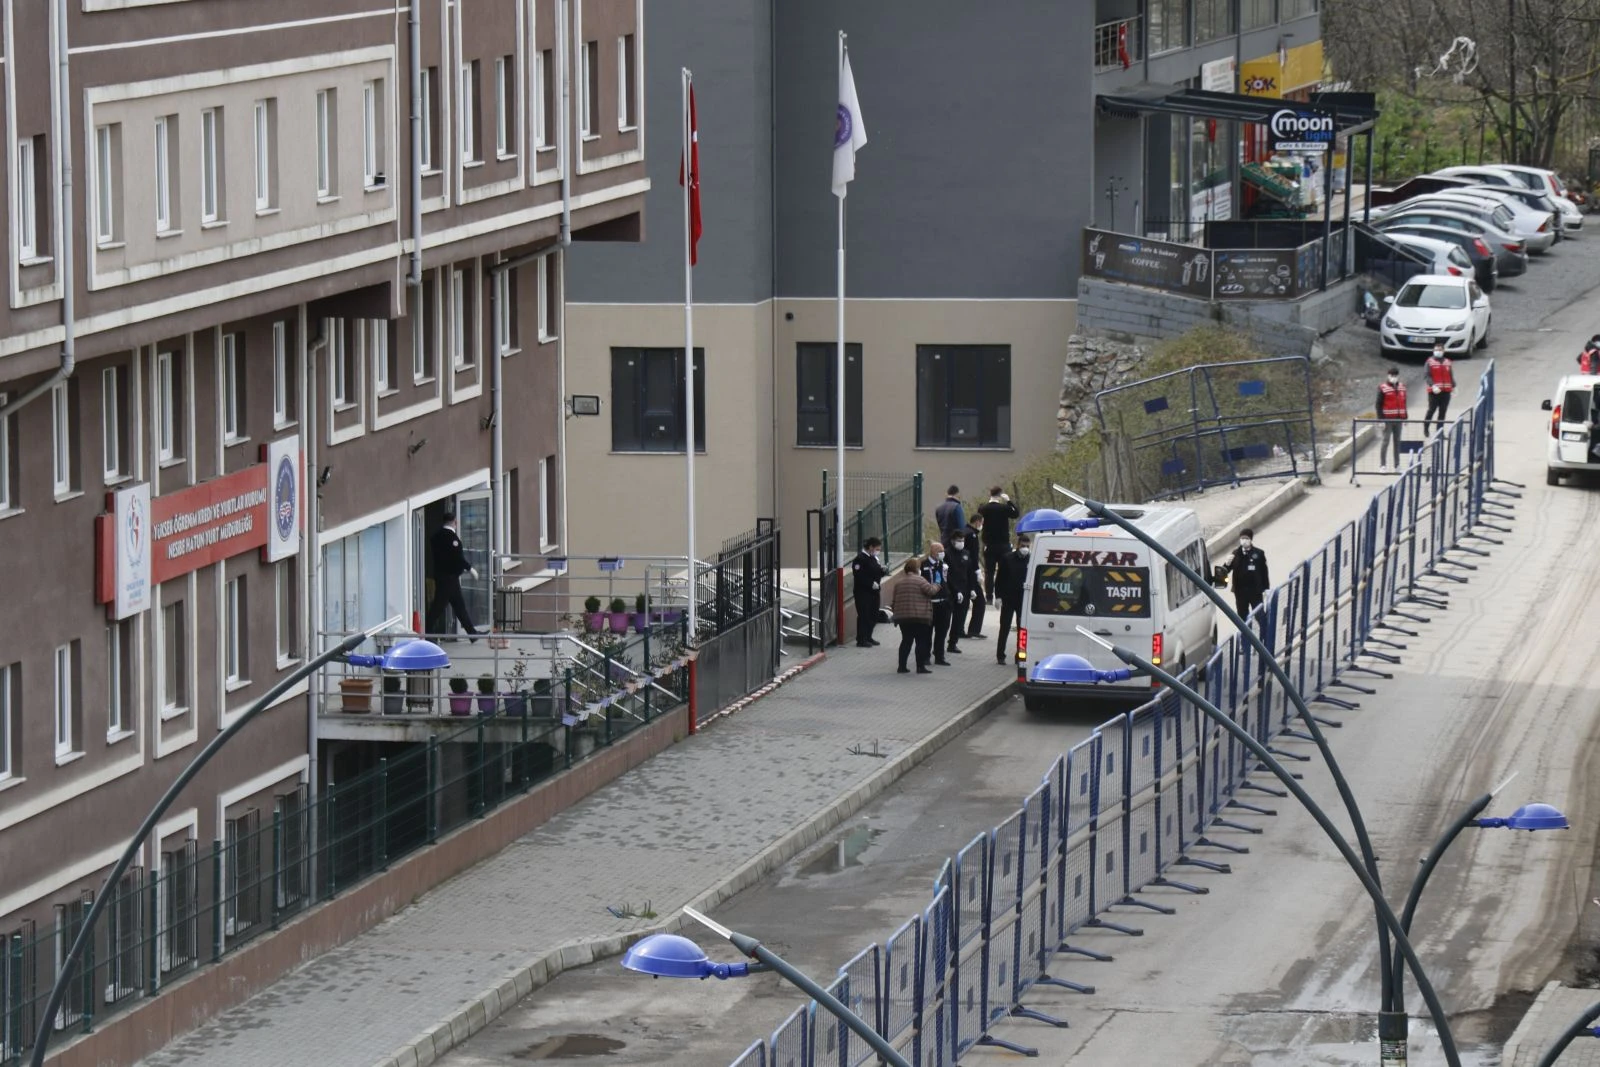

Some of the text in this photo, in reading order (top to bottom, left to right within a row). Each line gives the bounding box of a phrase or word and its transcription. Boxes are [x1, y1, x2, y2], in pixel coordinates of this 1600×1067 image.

[1278, 117, 1333, 131] moon
[1046, 549, 1138, 566] ERKAR
[1106, 586, 1142, 600] TAŞITI
